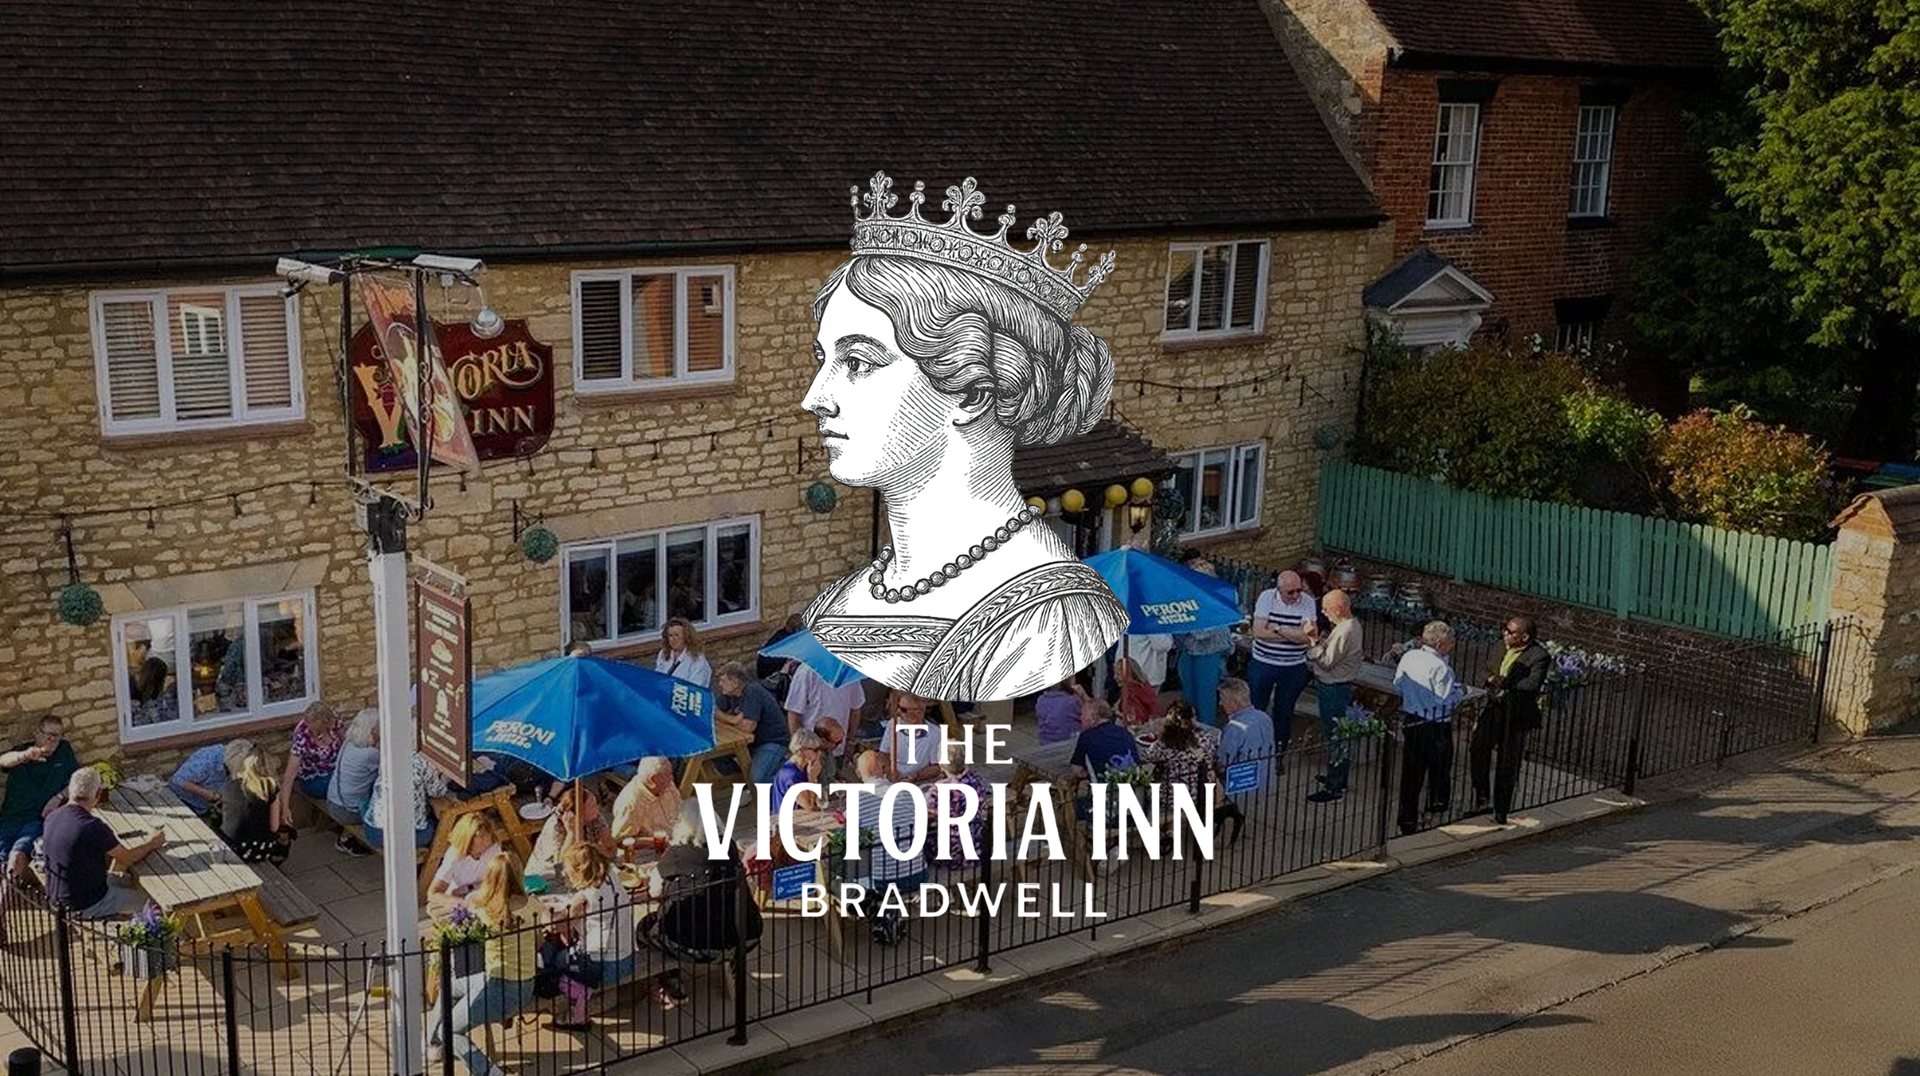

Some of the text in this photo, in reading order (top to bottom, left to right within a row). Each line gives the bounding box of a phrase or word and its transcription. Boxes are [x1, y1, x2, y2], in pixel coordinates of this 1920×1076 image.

[353, 340, 544, 449] VORIA
[471, 405, 536, 437] INN
[1141, 599, 1199, 617] PERONI
[486, 720, 556, 746] PERONI
